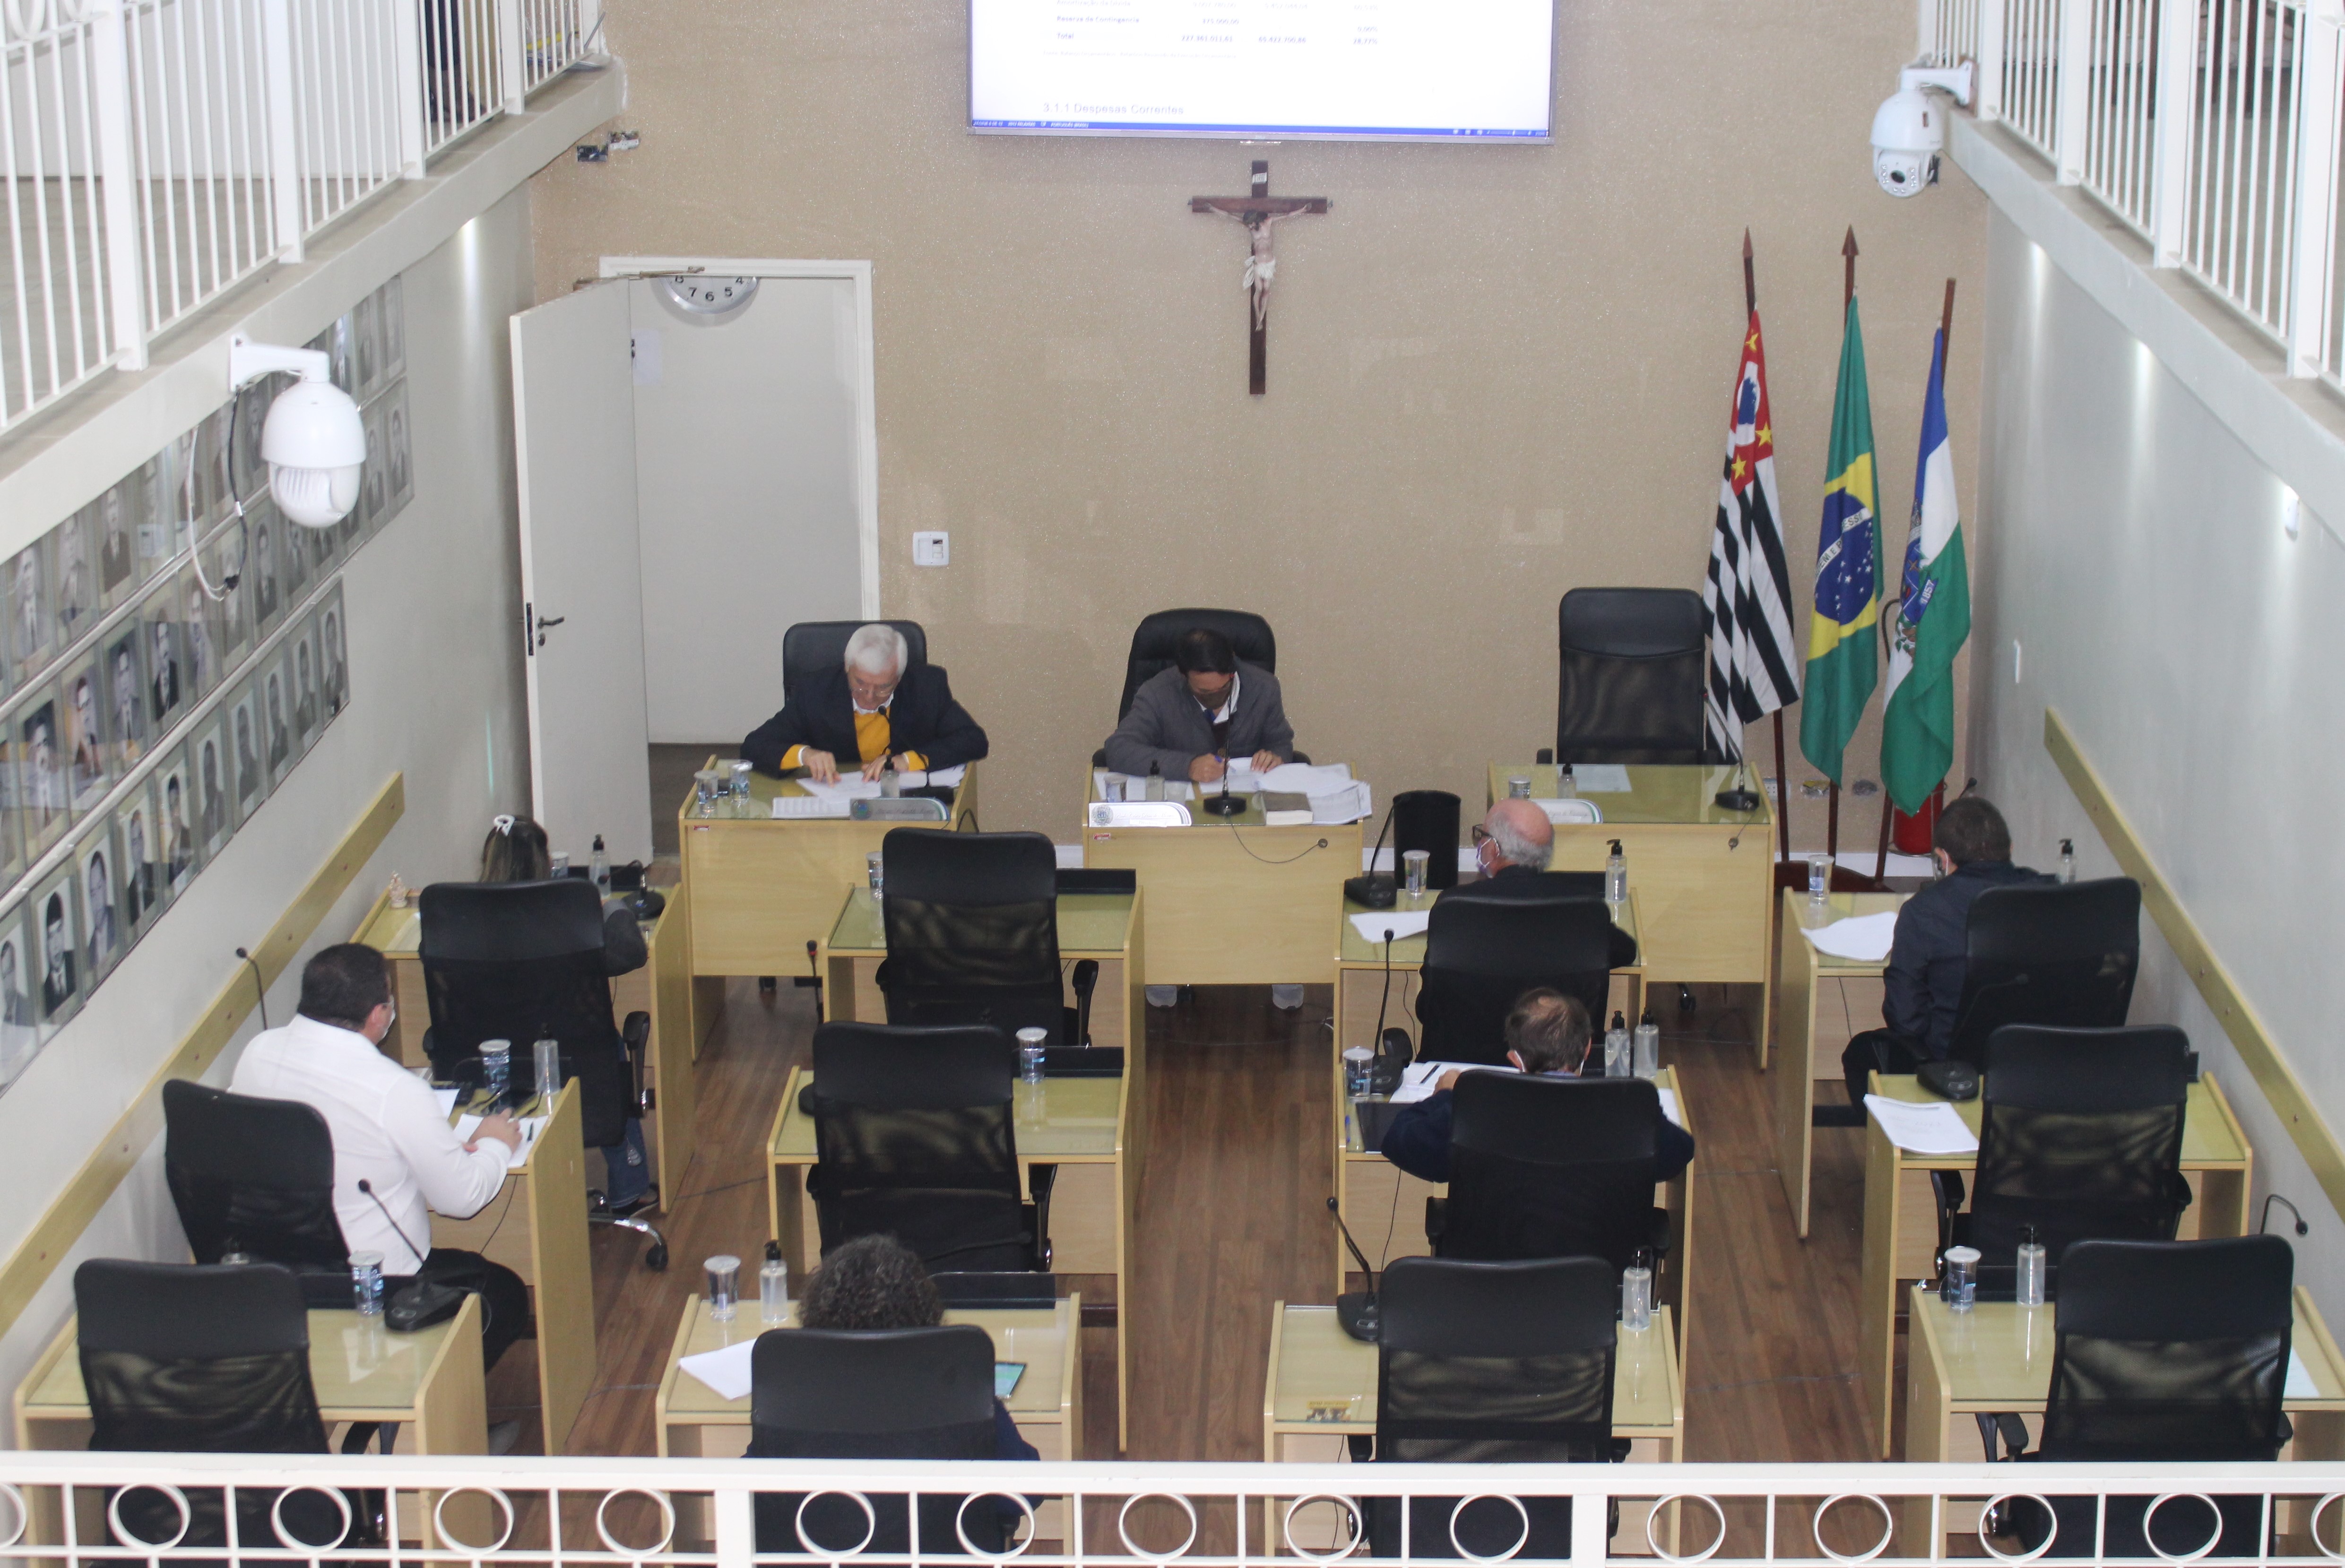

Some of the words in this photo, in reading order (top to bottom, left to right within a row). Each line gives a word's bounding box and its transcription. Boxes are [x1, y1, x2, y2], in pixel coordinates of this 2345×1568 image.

[1074, 103, 1127, 115] Despesas
[1131, 104, 1184, 114] Correntes
[688, 287, 697, 297] 7
[705, 292, 714, 302] 6
[725, 287, 732, 297] 5
[1921, 579, 1935, 604] 1857
